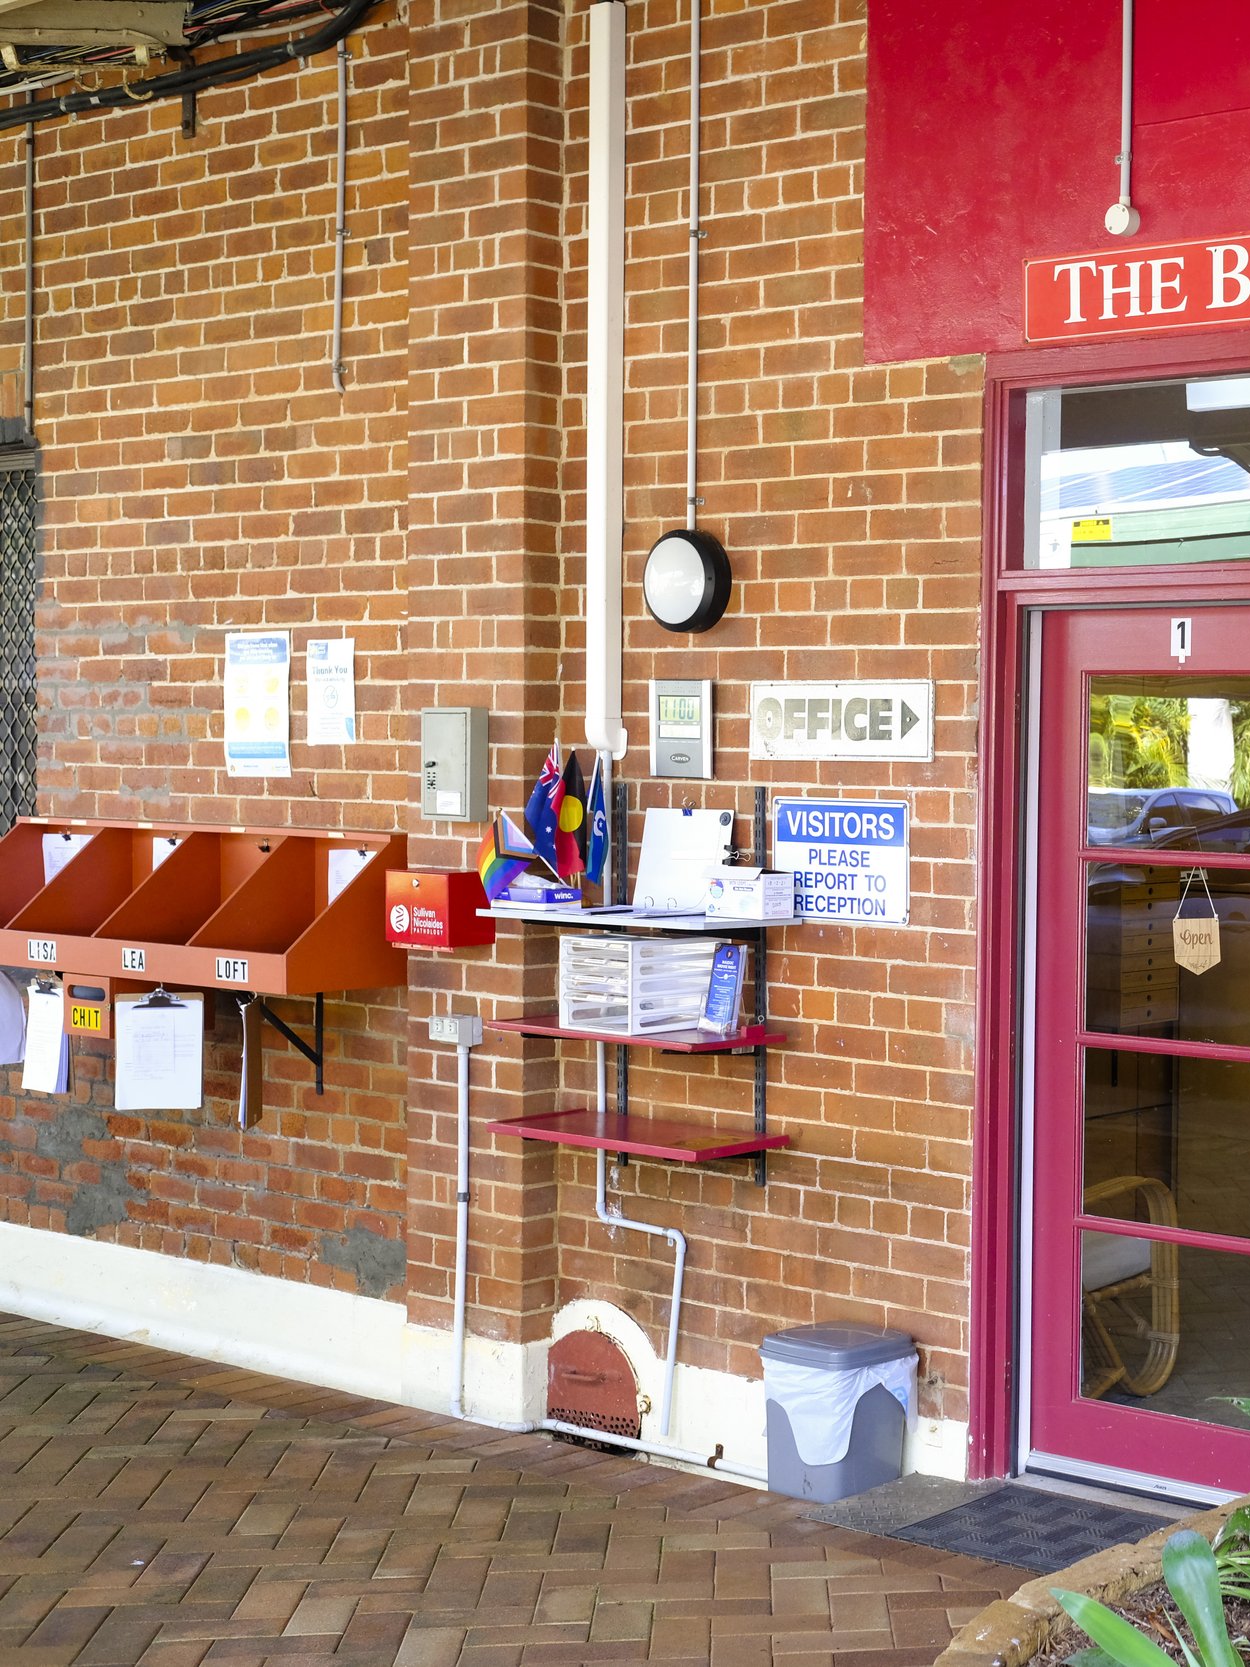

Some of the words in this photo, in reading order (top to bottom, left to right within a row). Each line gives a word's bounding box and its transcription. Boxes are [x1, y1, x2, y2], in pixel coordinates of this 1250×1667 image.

[1053, 256, 1188, 324] THE
[1177, 621, 1186, 650] 1
[334, 665, 348, 674] You
[757, 697, 893, 741] OFFICE
[786, 810, 895, 840] VISITORS
[808, 848, 871, 868] PLEASE
[793, 870, 858, 891] REPORT
[864, 874, 887, 893] TO
[413, 906, 436, 918] Sullivan
[794, 893, 886, 916] RECEPTION
[413, 917, 443, 929] Nicolaides
[413, 928, 443, 936] PATHOLOGY
[1180, 929, 1213, 950] Open
[29, 941, 56, 961] LISA
[123, 950, 144, 970] LEA
[217, 959, 247, 980] LOFT
[72, 1007, 100, 1028] CHIT
